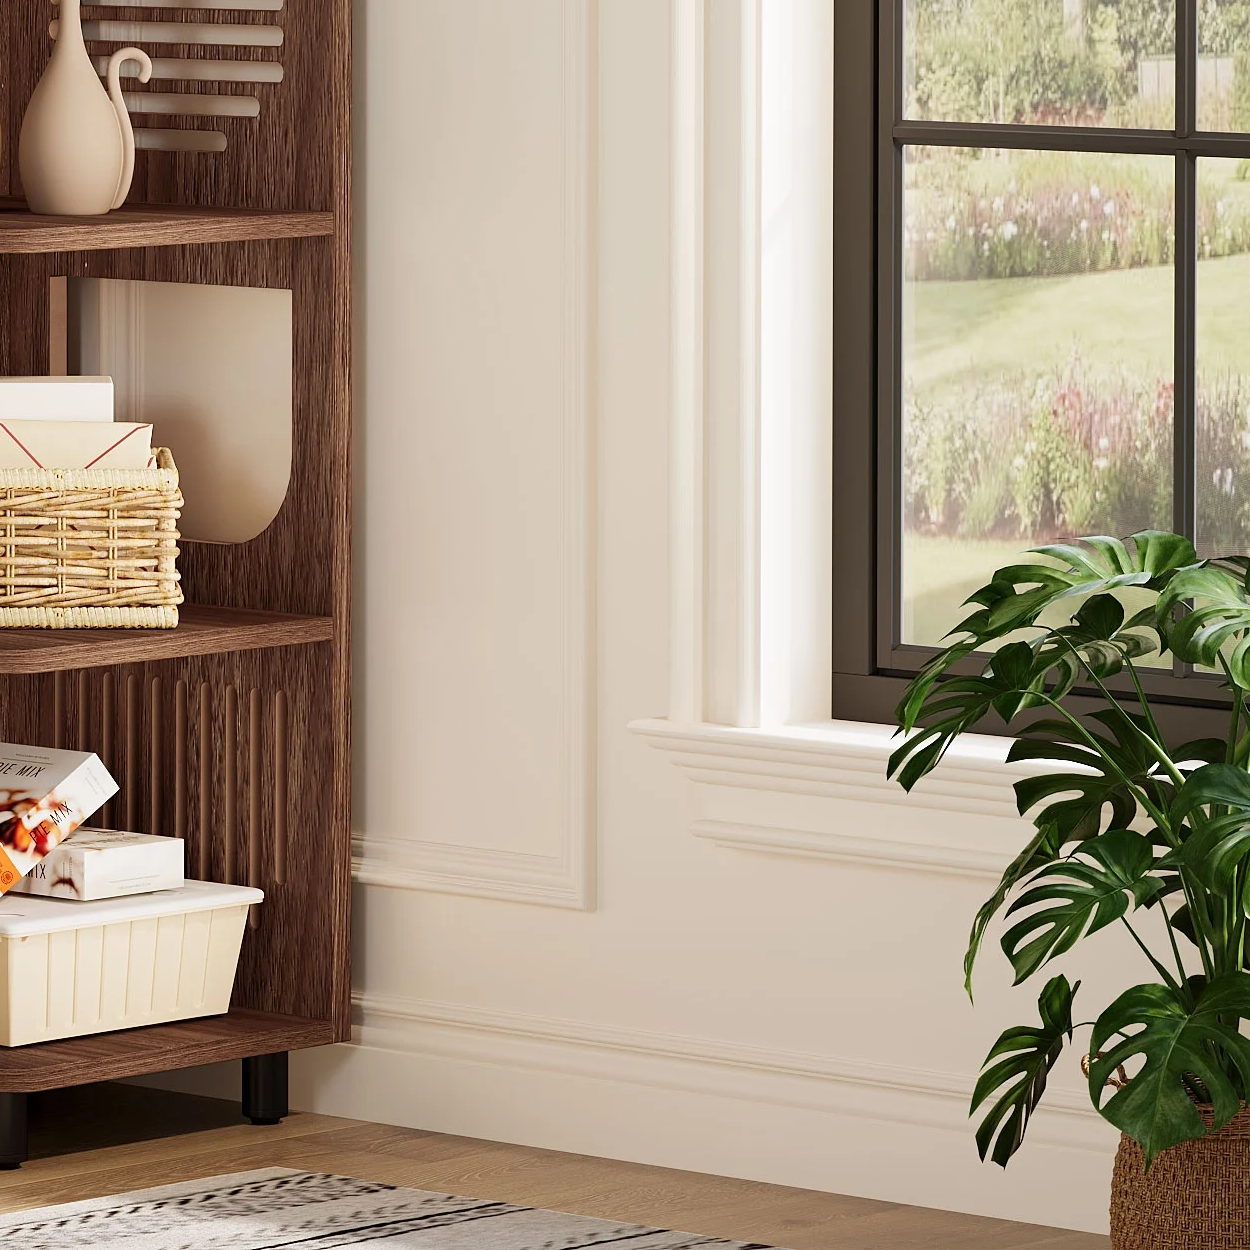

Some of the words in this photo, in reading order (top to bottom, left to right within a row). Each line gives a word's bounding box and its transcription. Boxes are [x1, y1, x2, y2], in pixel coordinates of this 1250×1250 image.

[15, 765, 46, 778] MIX
[28, 820, 51, 844] PIE
[49, 800, 73, 826] MIX
